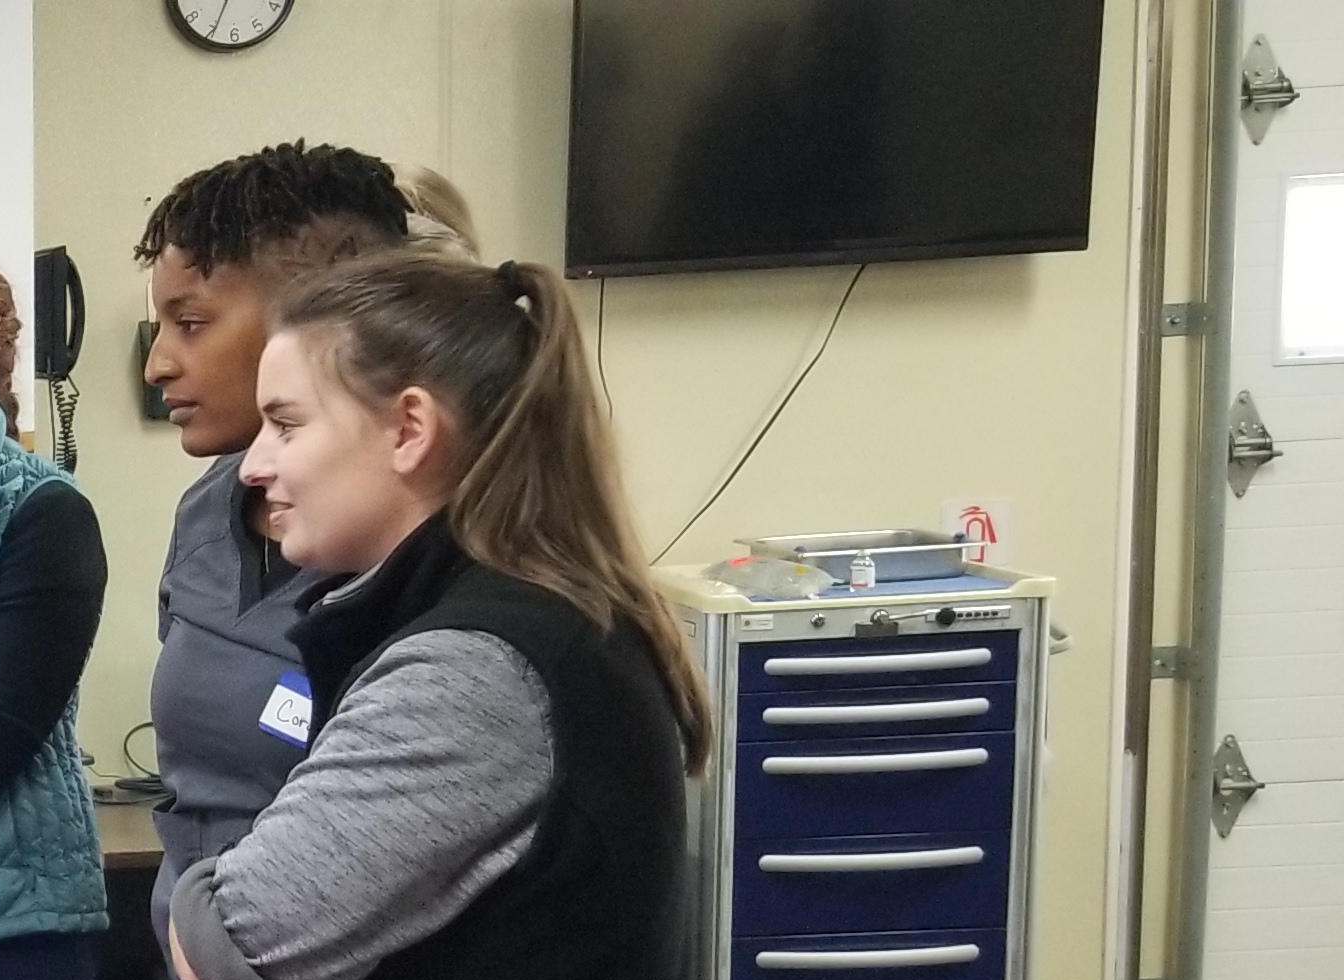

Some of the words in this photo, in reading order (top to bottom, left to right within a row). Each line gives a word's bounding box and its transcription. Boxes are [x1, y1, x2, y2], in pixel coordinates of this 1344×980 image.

[268, 0, 281, 12] 4
[185, 10, 199, 24] 8
[251, 18, 264, 33] 5
[229, 27, 240, 43] 6
